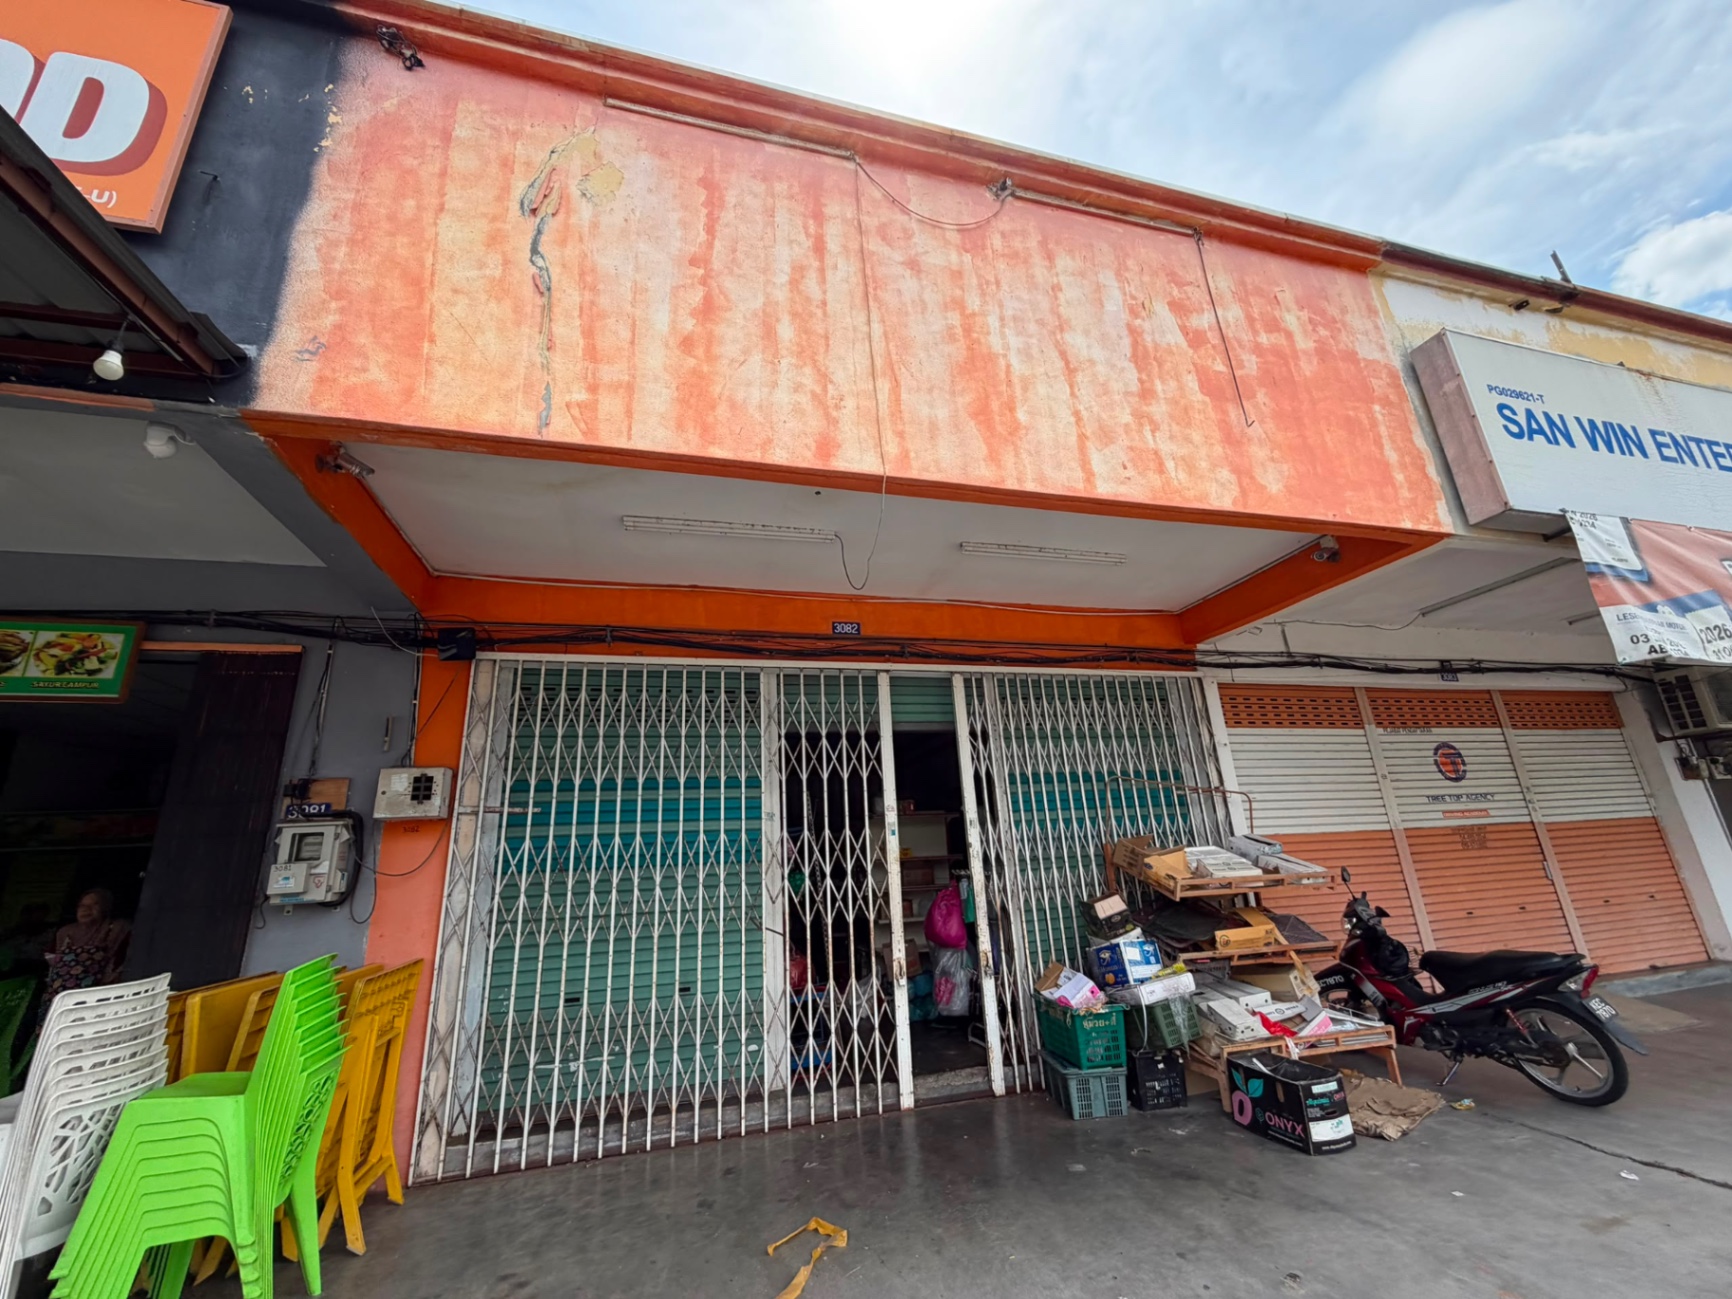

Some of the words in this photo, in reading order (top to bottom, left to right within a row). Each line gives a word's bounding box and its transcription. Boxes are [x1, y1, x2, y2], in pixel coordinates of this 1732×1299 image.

[1486, 383, 1545, 404] PG029621-T
[1496, 402, 1577, 449] SAN
[1573, 415, 1650, 460] WIN
[1647, 427, 1732, 473] ENTE
[834, 623, 859, 634] 3082
[1630, 633, 1650, 645] 03
[1425, 795, 1447, 803] TREE
[1466, 793, 1495, 801] AGENCY
[273, 864, 292, 872] 3081
[1596, 1005, 1617, 1020] 7870
[1265, 1111, 1306, 1139] ONYX
